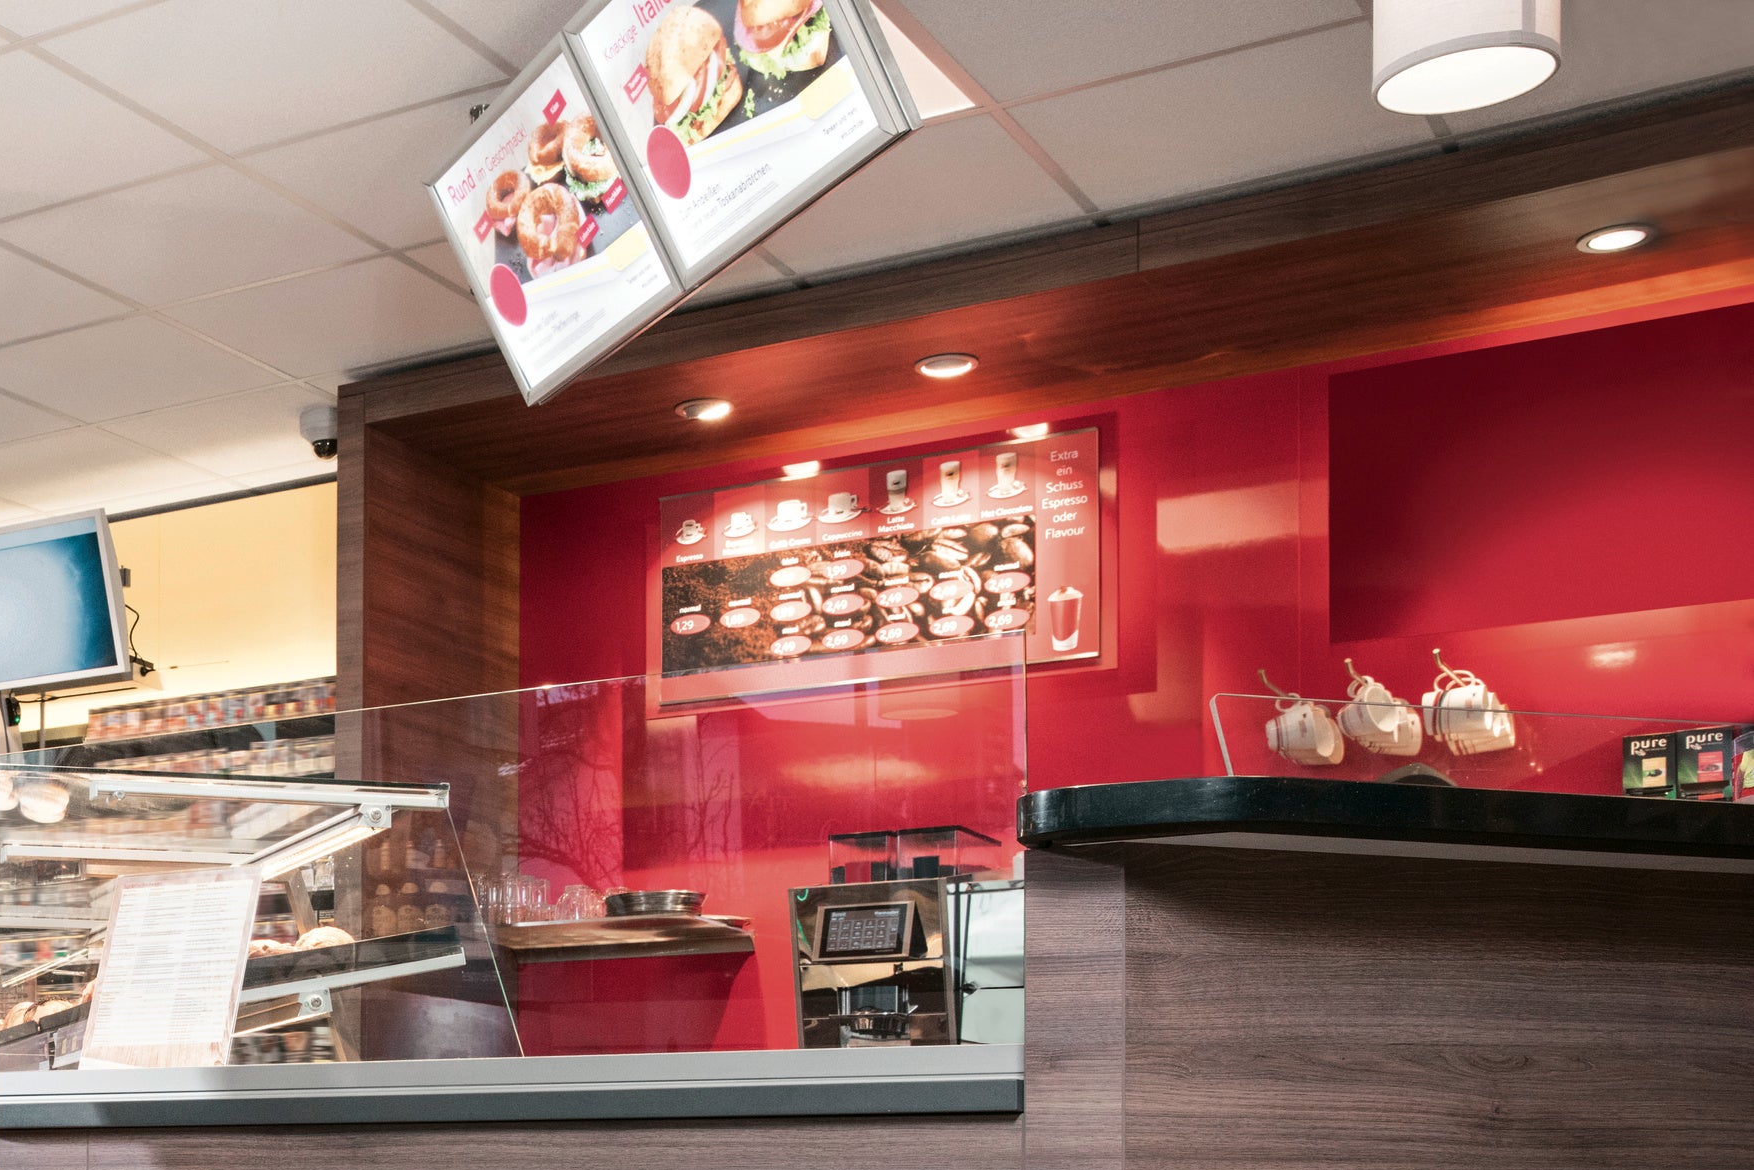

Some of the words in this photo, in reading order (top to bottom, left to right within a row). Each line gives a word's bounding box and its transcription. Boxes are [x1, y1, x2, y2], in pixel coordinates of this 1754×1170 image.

[447, 169, 477, 207] Rund
[1050, 450, 1079, 462] Extra
[1056, 465, 1073, 477] ein
[1045, 480, 1084, 493] Schuss
[1041, 495, 1088, 510] Espresso
[887, 515, 906, 525] Latte
[1052, 511, 1077, 523] oder
[821, 529, 863, 543] Cappuccino
[1045, 526, 1085, 540] Flavour
[675, 552, 704, 565] Espresso
[679, 604, 701, 613] normal
[675, 619, 694, 634] 1,29
[825, 632, 848, 647] 2,69
[1631, 738, 1667, 756] pure
[1686, 732, 1724, 750] pure
